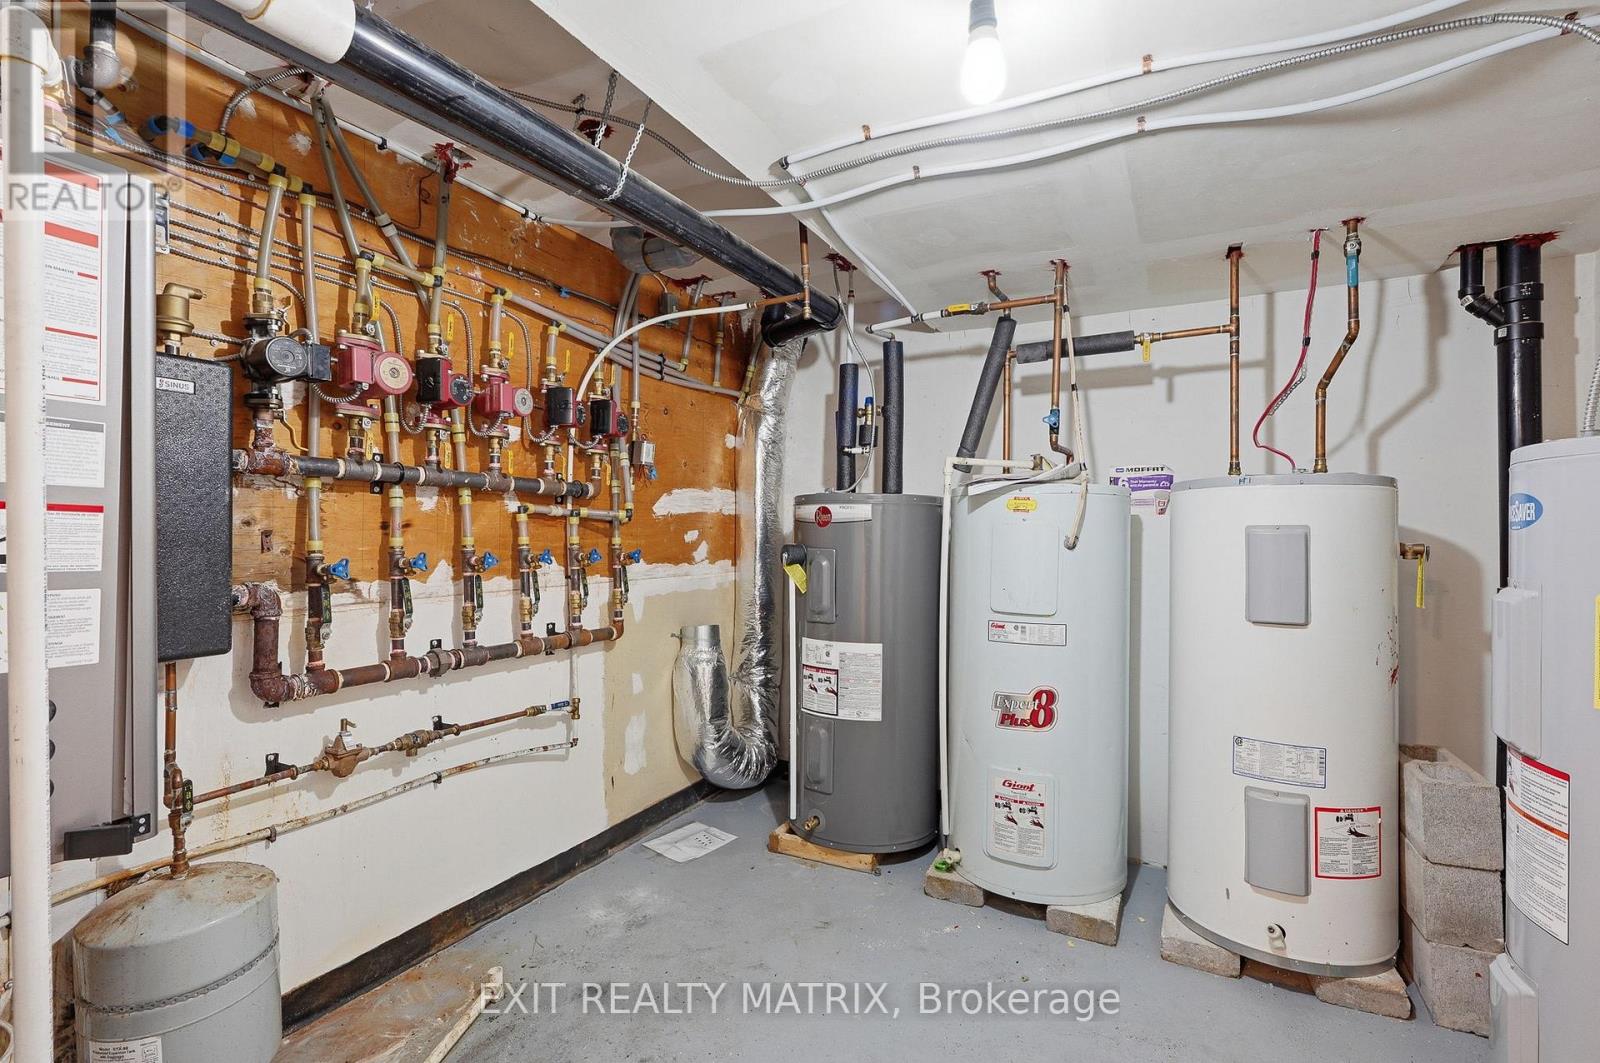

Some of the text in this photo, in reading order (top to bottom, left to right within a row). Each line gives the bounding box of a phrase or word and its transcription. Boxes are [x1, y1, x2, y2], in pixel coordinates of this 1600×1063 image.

[164, 380, 190, 391] SINUS
[996, 695, 1041, 712] Expert
[1030, 689, 1055, 728] 8
[1000, 712, 1032, 728] Plus
[1002, 779, 1035, 792] Giant
